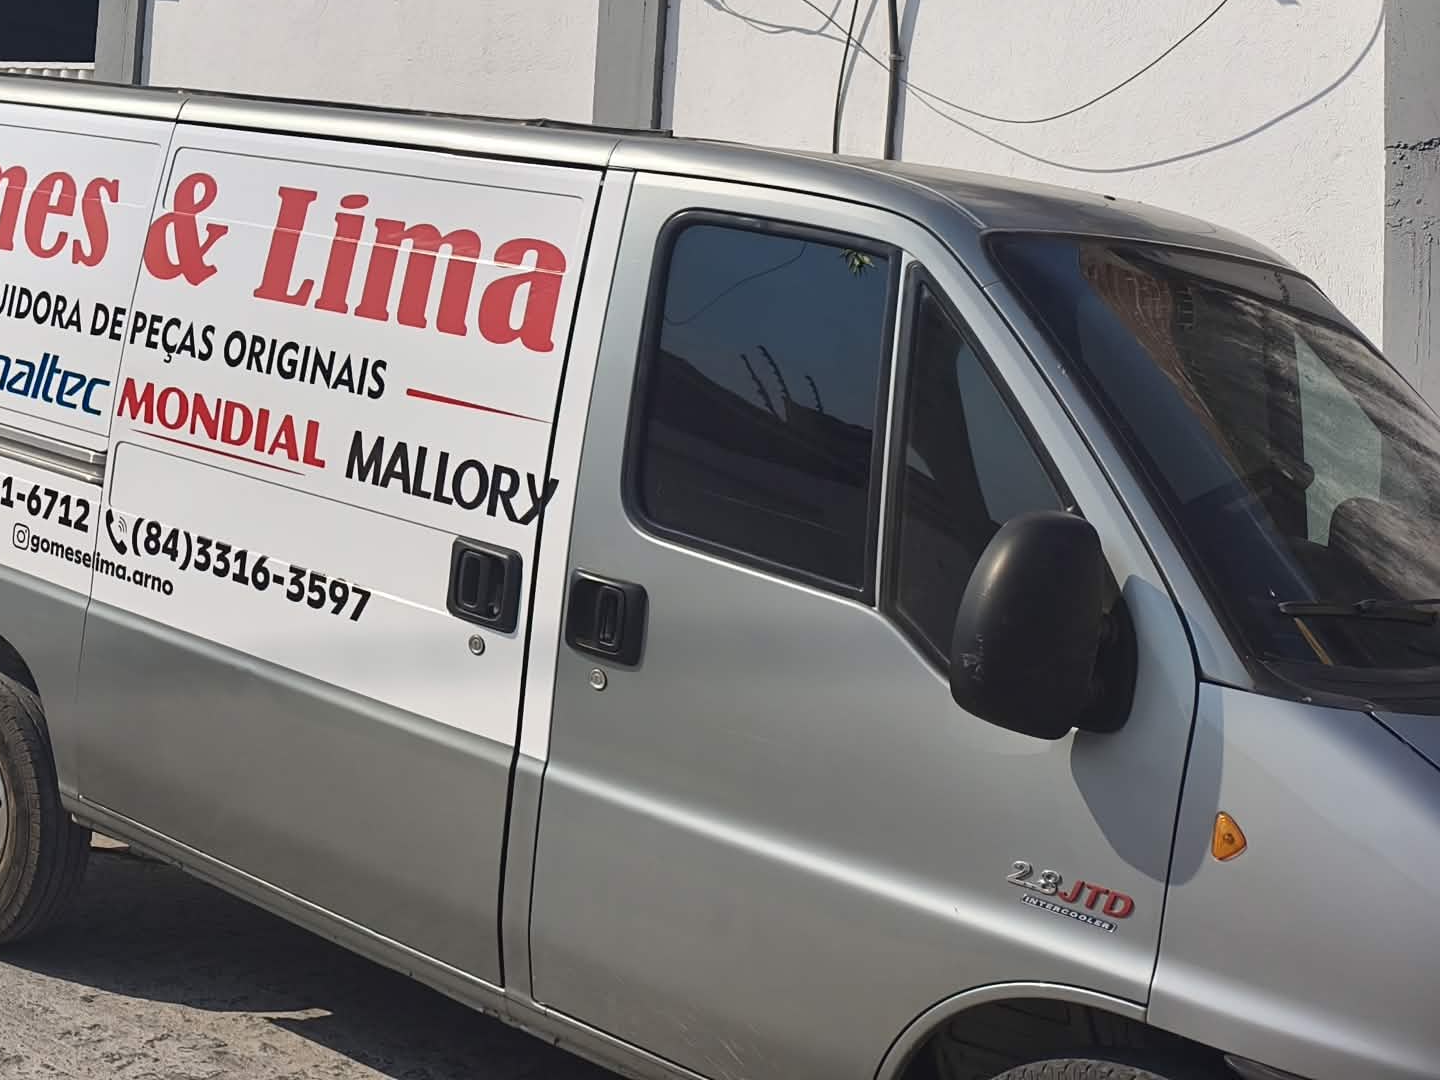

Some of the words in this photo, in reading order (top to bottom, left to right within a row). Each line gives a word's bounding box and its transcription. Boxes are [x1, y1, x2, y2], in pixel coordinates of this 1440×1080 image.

[144, 172, 229, 287] &
[253, 186, 567, 353] Lima
[90, 302, 127, 340] DE
[129, 311, 215, 364] PEÇAS
[223, 330, 388, 400] ORIGINAIS
[117, 377, 326, 469] MONDIAL
[345, 430, 559, 526] MALLORY
[30, 533, 174, 596] gomeselima.arno
[131, 517, 372, 623] (84)3316-3597
[1024, 896, 1112, 931] INTERCOOLER
